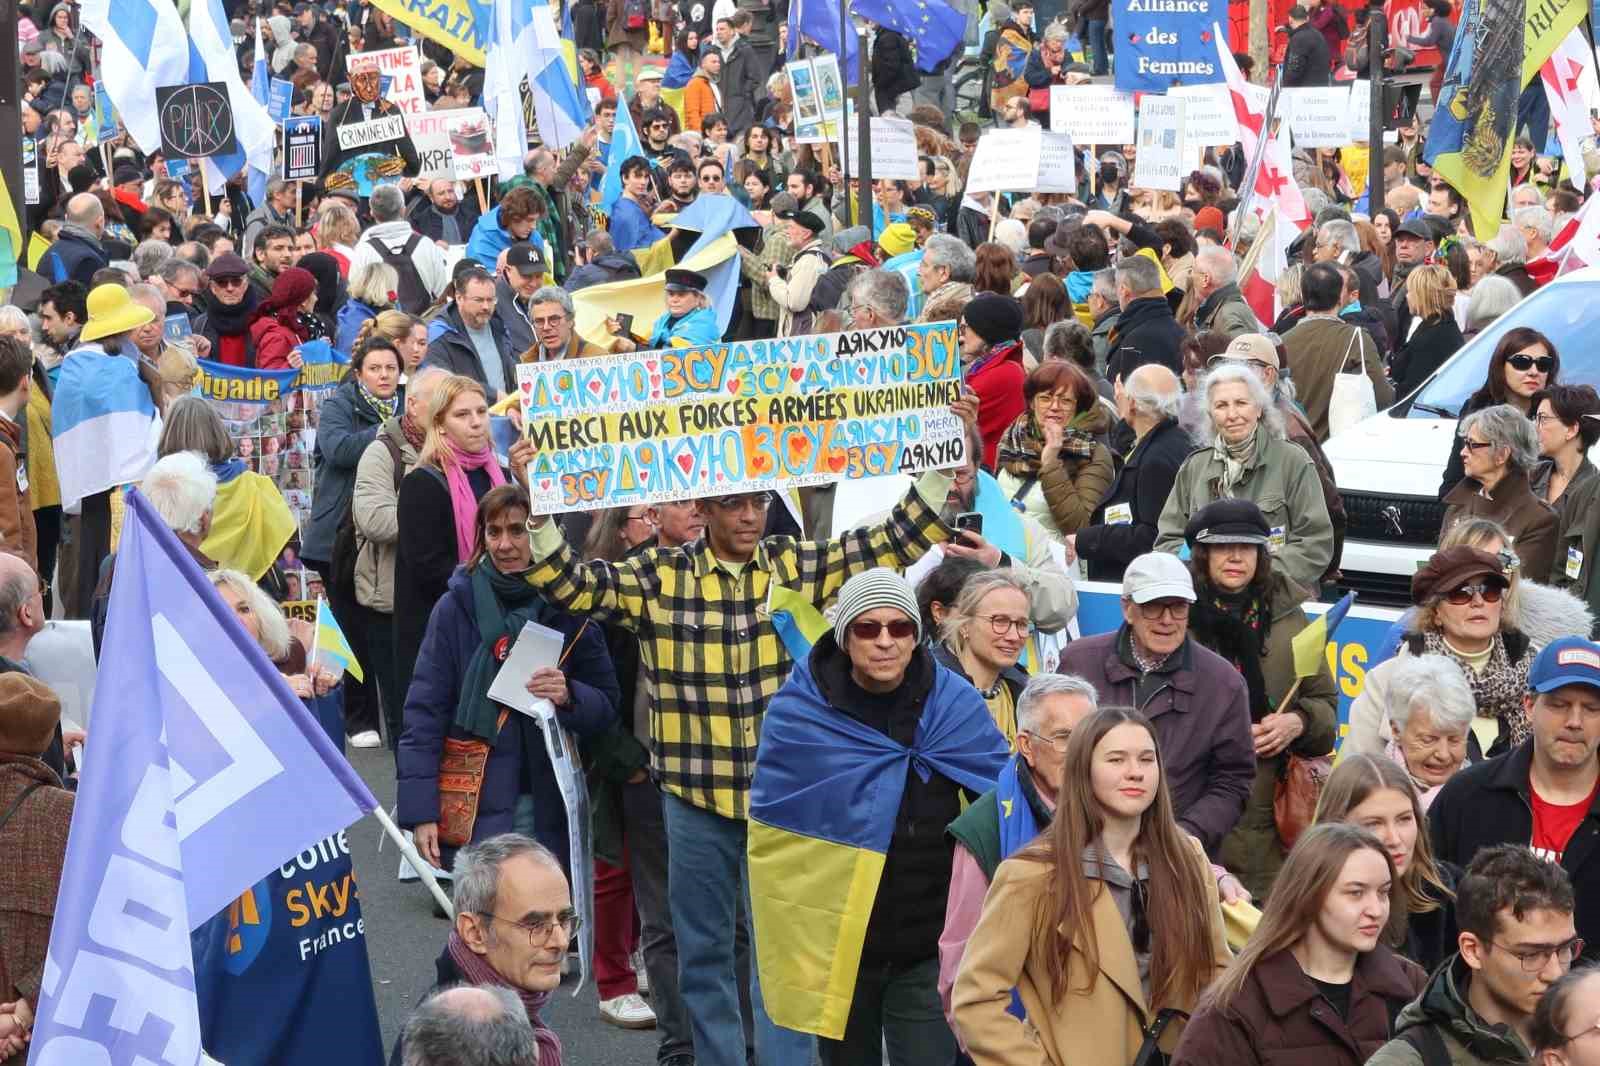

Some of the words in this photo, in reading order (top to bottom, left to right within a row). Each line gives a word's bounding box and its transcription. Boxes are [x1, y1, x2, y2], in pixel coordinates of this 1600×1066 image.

[1127, 0, 1209, 12] Alliance
[1146, 26, 1178, 44] des
[394, 75, 415, 92] LA
[1138, 56, 1215, 75] Femmes
[528, 361, 650, 418] ДЯКУЮ
[662, 347, 730, 398] ЗСУ
[729, 336, 831, 371] ДЯКУЮ
[836, 327, 905, 358] ДЯКУЮ
[905, 328, 959, 380] ЗСУ
[740, 366, 790, 398] ЗСУ
[800, 353, 905, 395] ДЯКУЮ
[528, 415, 608, 451] MERCI
[619, 410, 669, 442] AUX
[679, 397, 758, 433] FORCES
[768, 387, 848, 425] ARMÉES
[854, 379, 961, 417] UKRAINIENNES
[611, 430, 745, 503] ДЯКУЮ
[755, 424, 825, 480] ЗСУ
[847, 442, 899, 479] ЗСУ
[898, 438, 964, 472] ДЯКУЮ
[561, 467, 612, 506] ЗСУ
[286, 868, 361, 927] Sky
[299, 919, 365, 961] France
